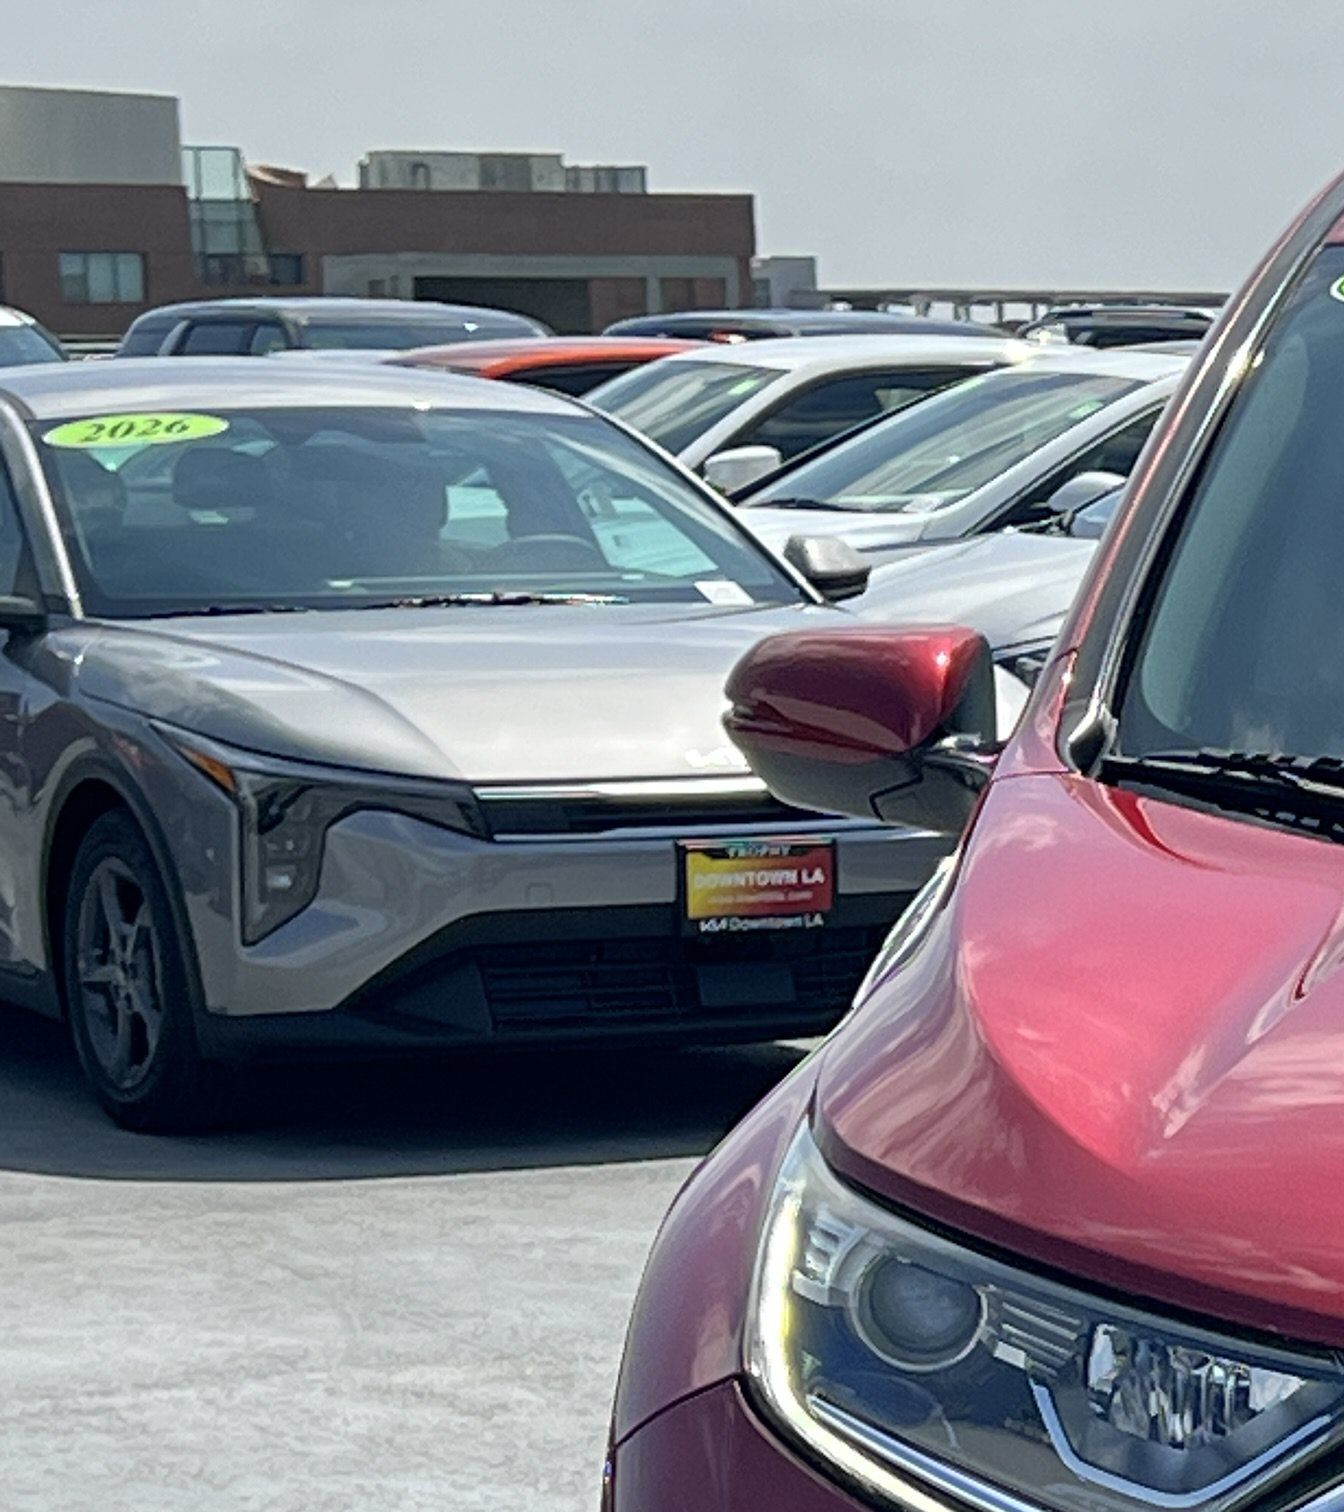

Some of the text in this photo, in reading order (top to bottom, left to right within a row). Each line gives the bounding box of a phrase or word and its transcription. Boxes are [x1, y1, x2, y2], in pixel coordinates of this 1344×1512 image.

[80, 418, 190, 443] 2026
[696, 868, 824, 888] DOWNTOWN LA
[804, 913, 824, 928] LA
